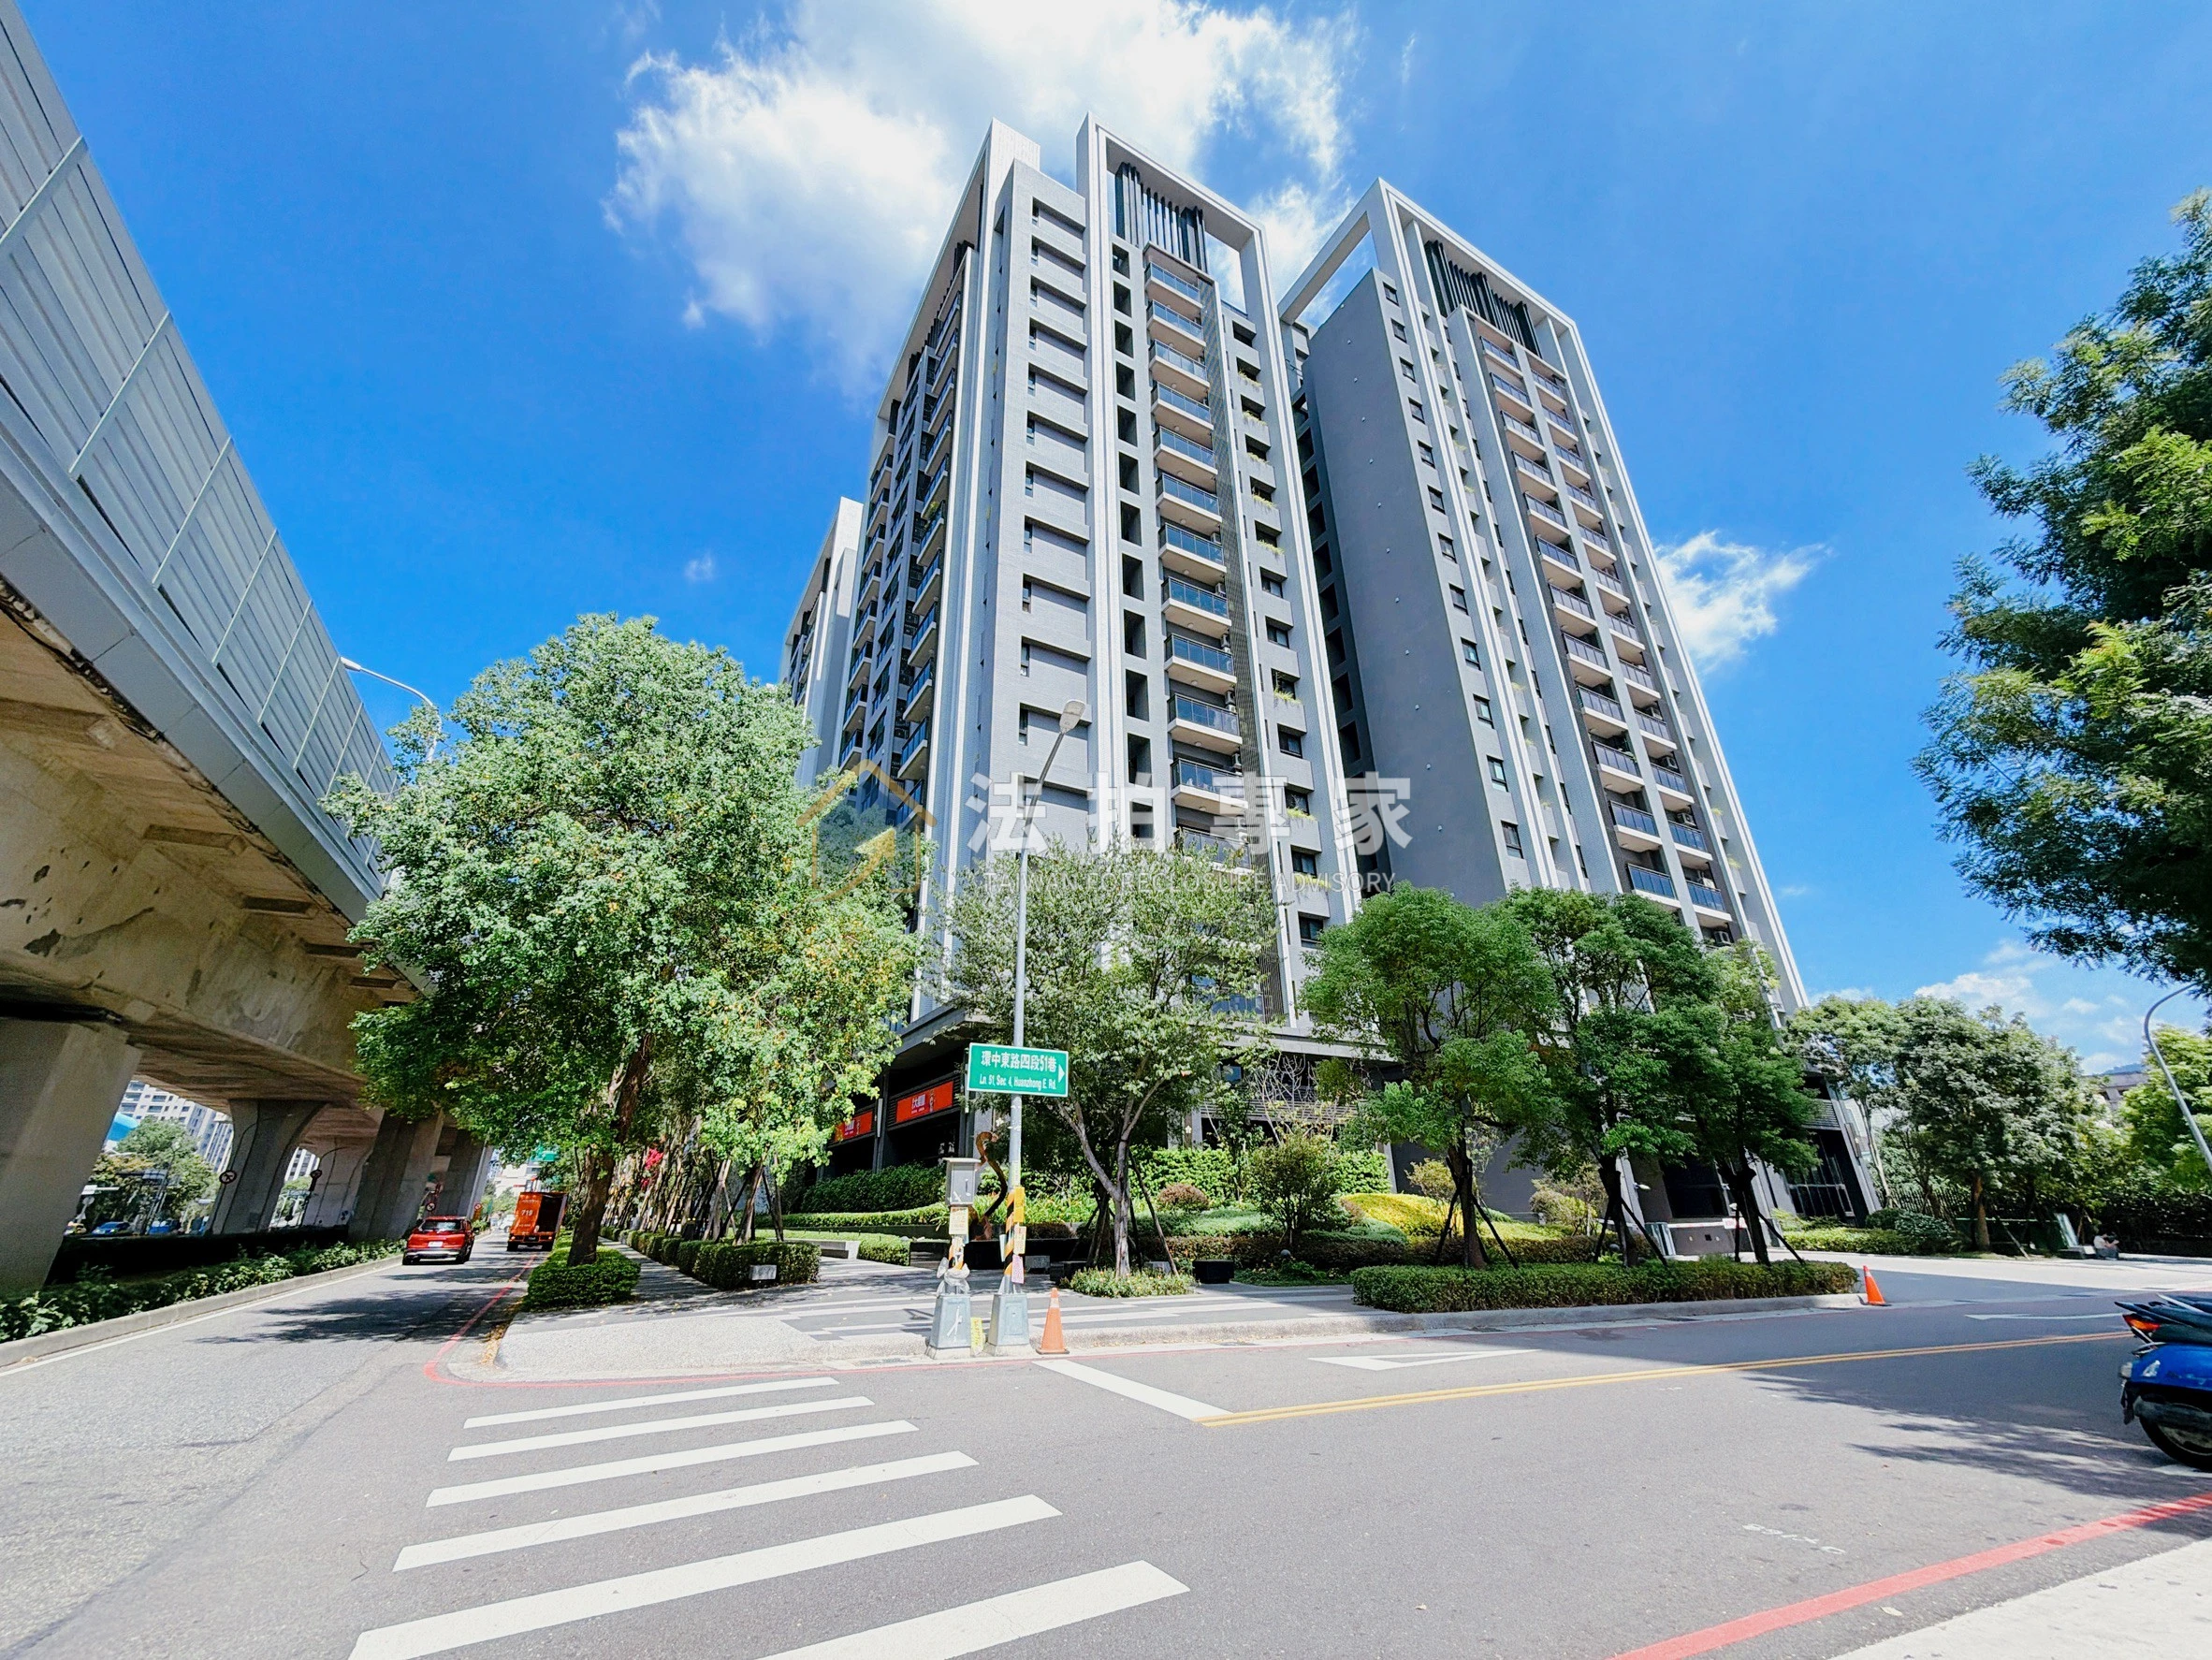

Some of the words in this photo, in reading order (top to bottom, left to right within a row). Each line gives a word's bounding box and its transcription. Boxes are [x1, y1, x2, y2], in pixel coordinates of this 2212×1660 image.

[981, 1050, 1057, 1072] 環中東路四段51巷
